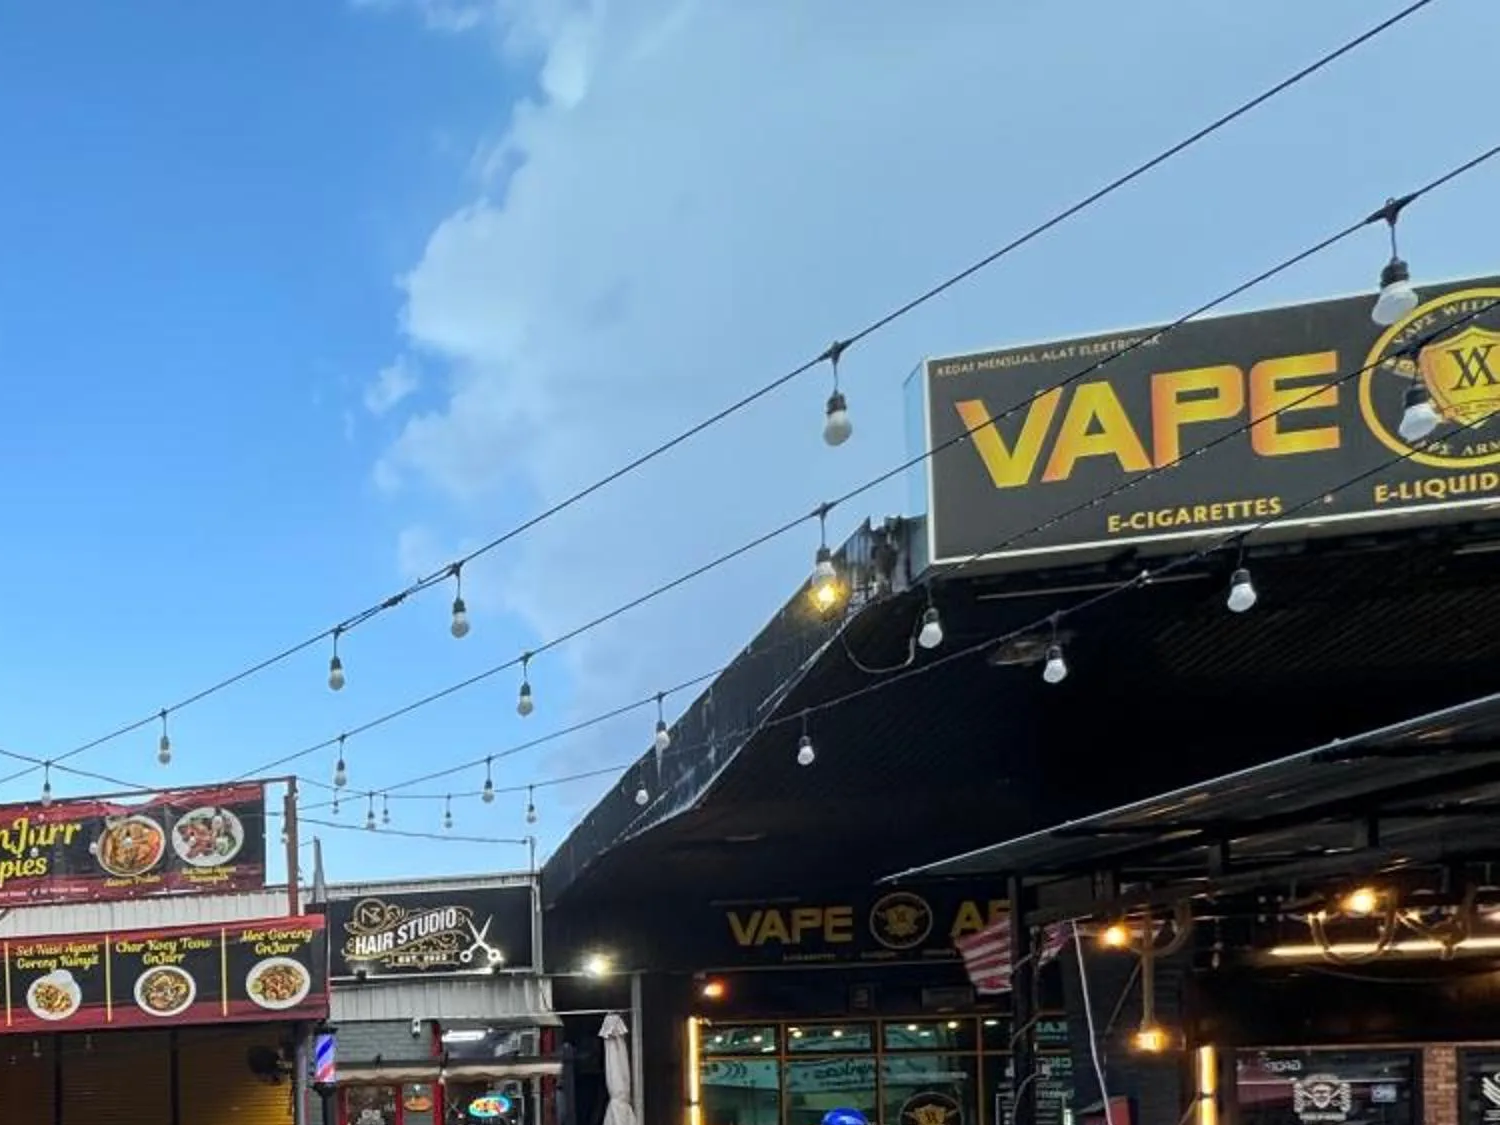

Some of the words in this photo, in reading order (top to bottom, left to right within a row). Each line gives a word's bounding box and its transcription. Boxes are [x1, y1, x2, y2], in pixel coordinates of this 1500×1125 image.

[955, 350, 1340, 489] VAPE
[1375, 472, 1499, 503] E-LIQUID
[1107, 496, 1282, 533] E-CIGARETTES
[355, 932, 394, 955] HAIR
[396, 908, 457, 945] STUDIO
[726, 905, 854, 946] VAPE
